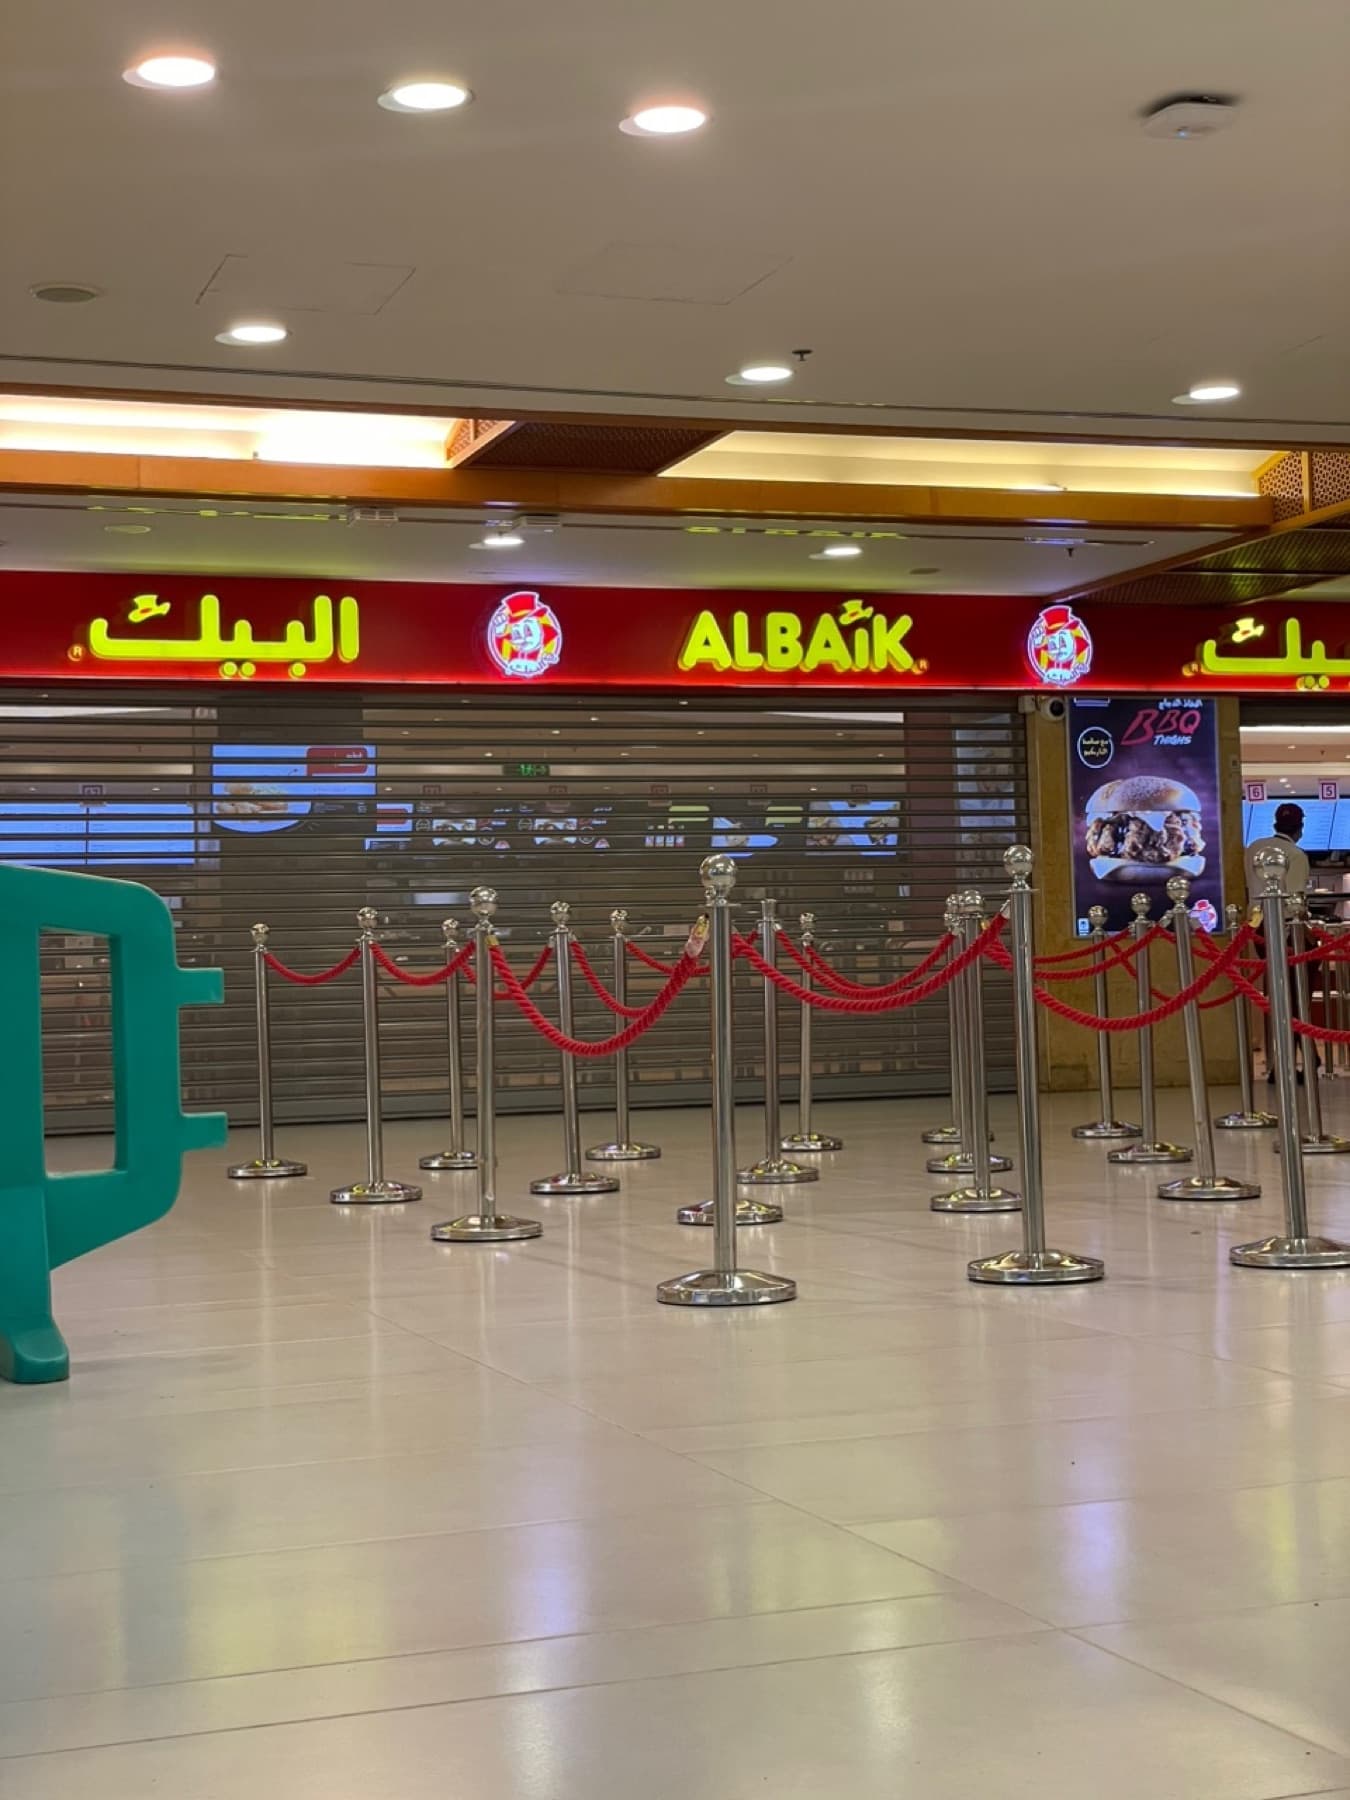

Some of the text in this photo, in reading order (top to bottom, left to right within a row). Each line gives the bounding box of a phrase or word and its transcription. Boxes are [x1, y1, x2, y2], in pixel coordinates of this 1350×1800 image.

[88, 594, 361, 679] البيك
[1120, 708, 1202, 746] BBQ
[1252, 787, 1260, 798] 6
[1325, 786, 1333, 797] 5
